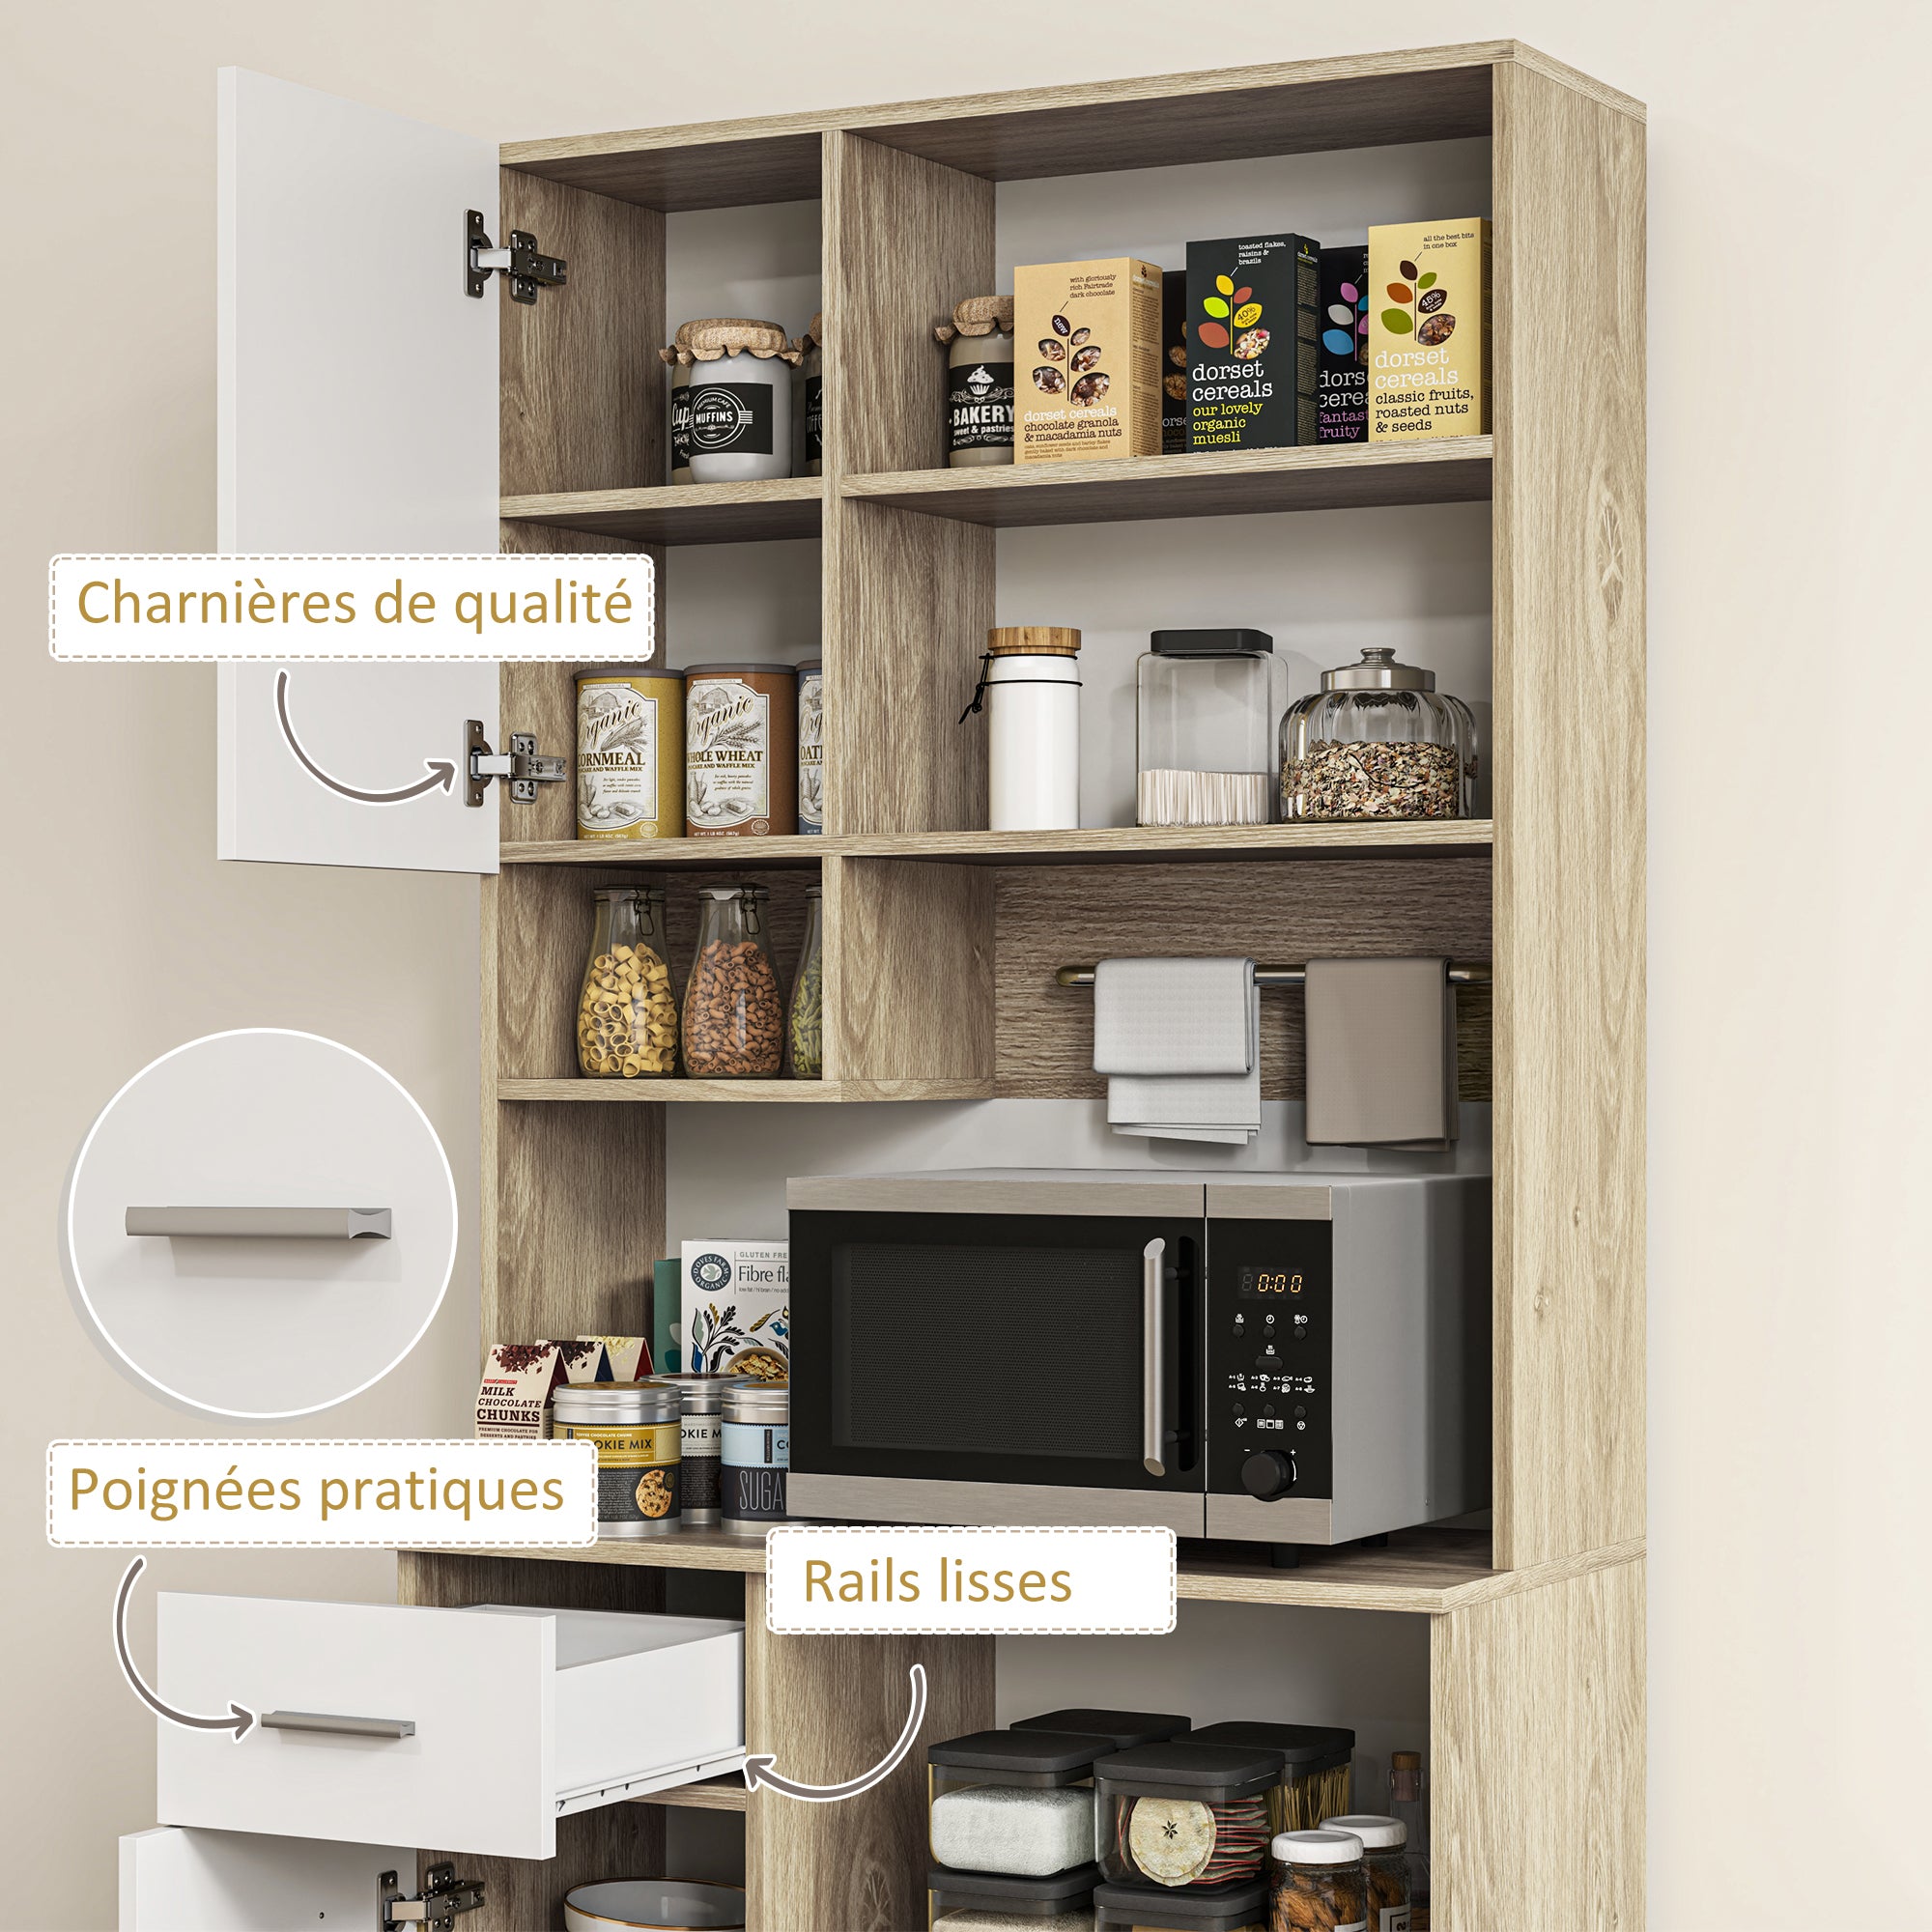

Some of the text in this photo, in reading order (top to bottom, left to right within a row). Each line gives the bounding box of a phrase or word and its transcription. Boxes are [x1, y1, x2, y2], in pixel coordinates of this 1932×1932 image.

[1085, 274, 1117, 283] gloriously
[1054, 318, 1068, 334] new
[1375, 348, 1450, 369] dorset
[1192, 360, 1264, 382] dorset
[1320, 370, 1369, 387] dors
[1375, 367, 1459, 389] cereals
[1192, 380, 1273, 402] cereals
[1376, 387, 1474, 405] classic fruits,
[696, 397, 718, 411] PREMIUM
[1193, 402, 1264, 417] our lovely
[1376, 403, 1469, 419] roasted nuts
[696, 412, 733, 424] MUFFINS
[953, 406, 1014, 426] BAKERY
[1024, 406, 1118, 422] dorset cereals
[971, 425, 979, 434] &
[1024, 417, 1119, 432] chocolate granola
[1193, 417, 1246, 433] organic
[1376, 419, 1433, 433] & seeds
[1024, 428, 1122, 442] & macadamia nuts
[1193, 431, 1241, 445] muesli
[715, 751, 763, 761] WHEAT
[694, 1256, 728, 1274] DOVES FARM
[739, 1264, 773, 1282] Fibre
[696, 1276, 728, 1290] ORGANIC
[1258, 1274, 1302, 1293] 0:00
[481, 1386, 515, 1397] MILK
[478, 1398, 541, 1408] CHOCOLATE
[477, 1408, 540, 1422] CHUNKS
[629, 1439, 652, 1449] MIX
[739, 1470, 783, 1511] SUGA
